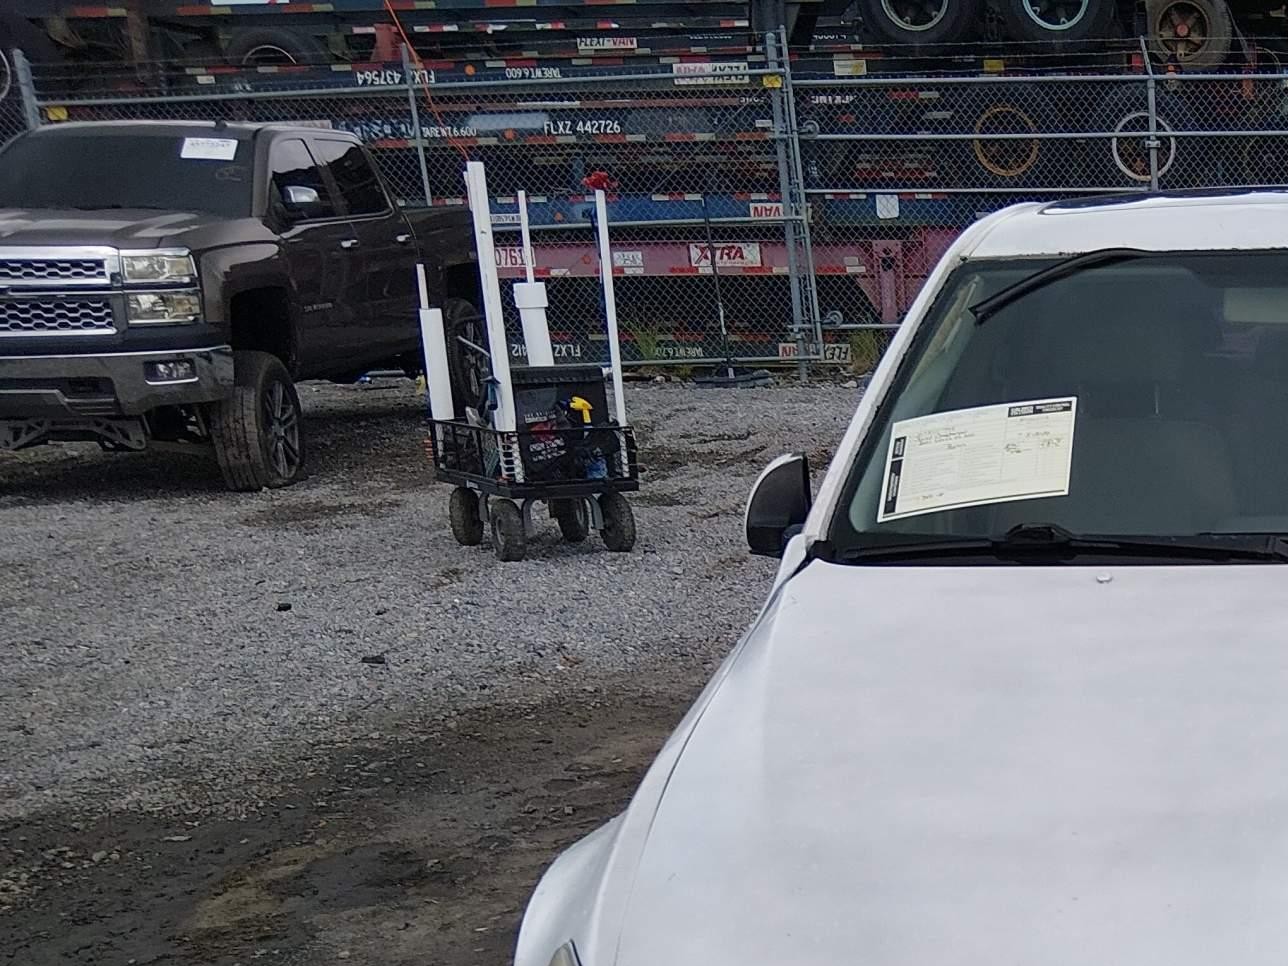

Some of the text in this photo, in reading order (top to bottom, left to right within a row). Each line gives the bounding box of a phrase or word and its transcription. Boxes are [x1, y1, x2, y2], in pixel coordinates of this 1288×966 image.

[357, 70, 402, 85] 437564
[543, 120, 621, 134] FLXZ 442726
[552, 344, 581, 356] FLXZ
